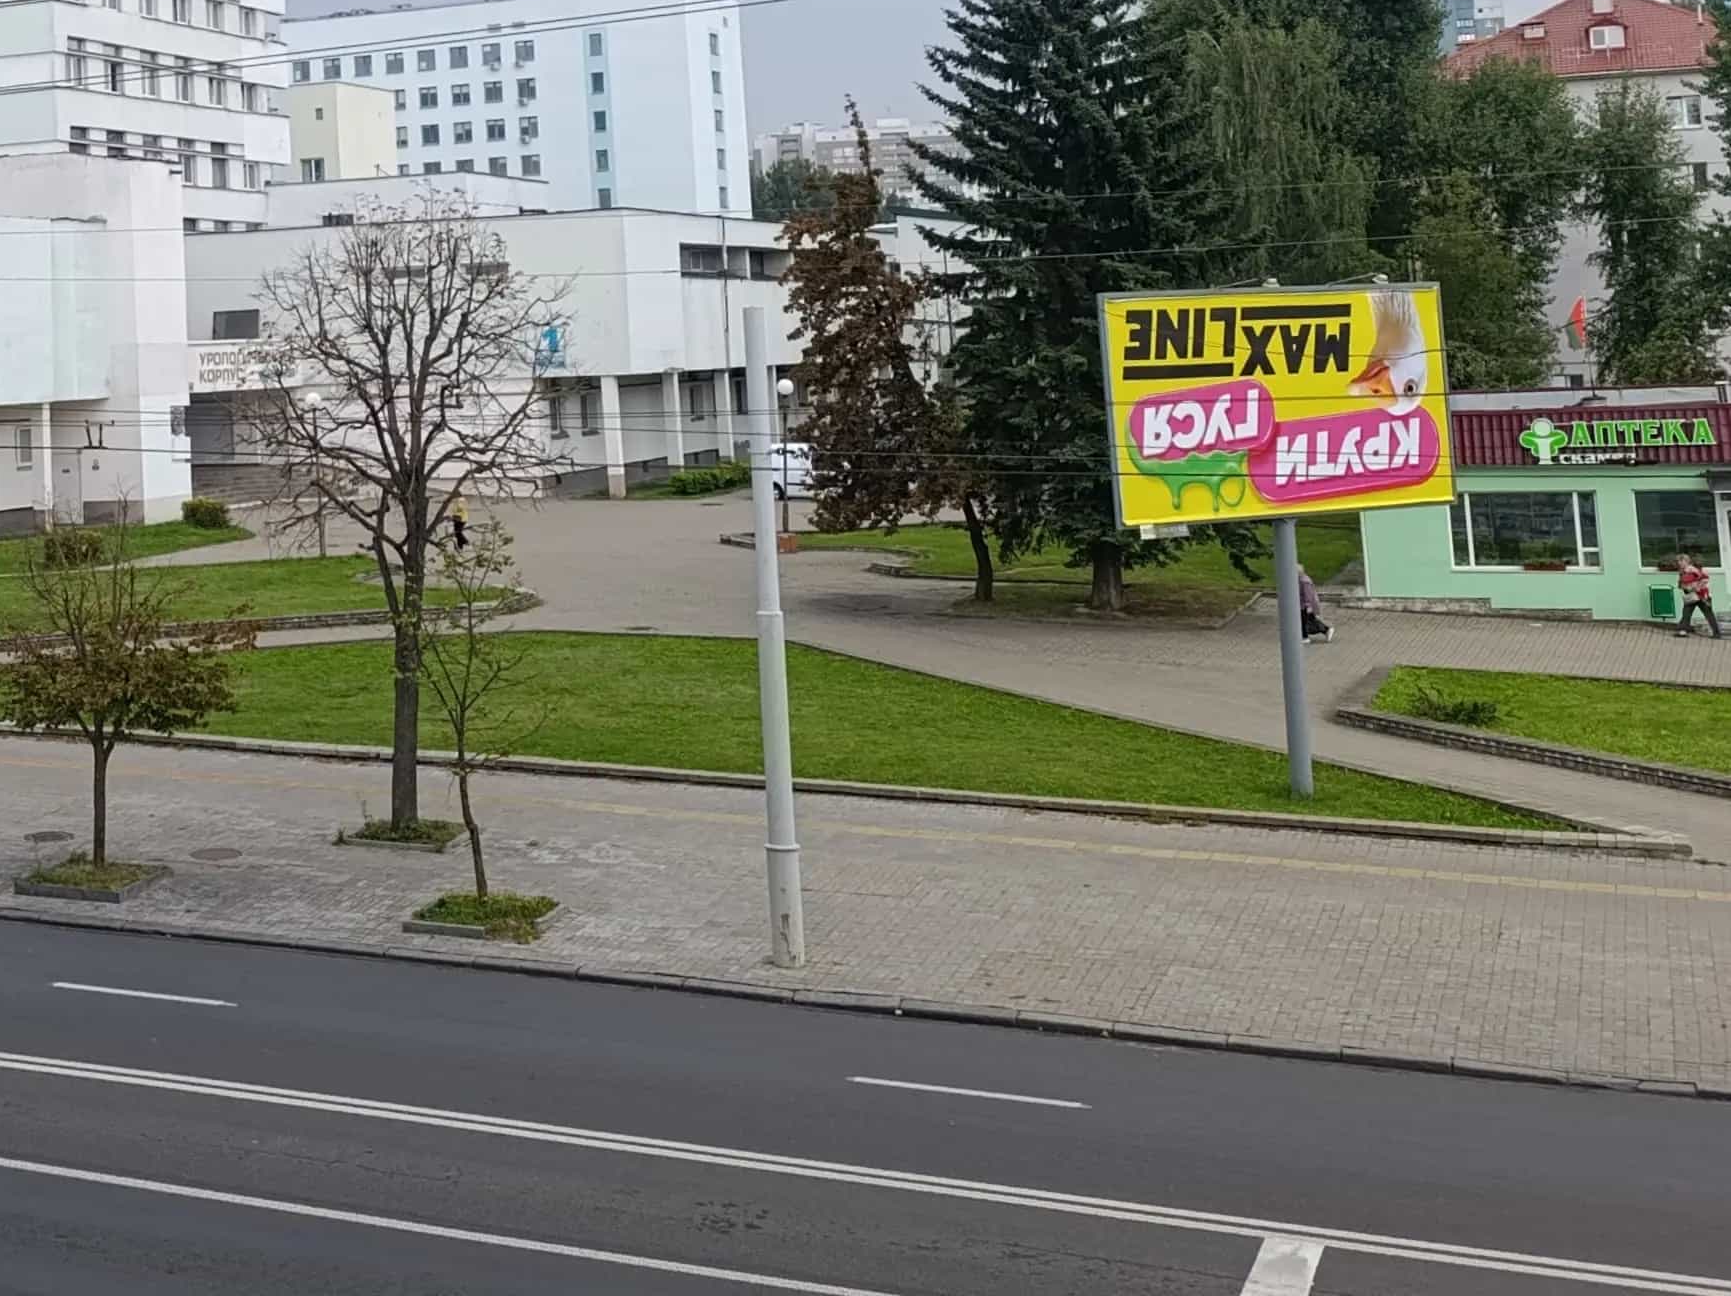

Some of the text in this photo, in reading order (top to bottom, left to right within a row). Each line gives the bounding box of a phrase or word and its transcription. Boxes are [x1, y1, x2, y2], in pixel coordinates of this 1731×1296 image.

[199, 368, 244, 384] КОРПУС
[1142, 388, 1259, 456] ГУСЯ
[1570, 418, 1716, 447] АПТЕКА
[1276, 418, 1420, 485] КРУТИ
